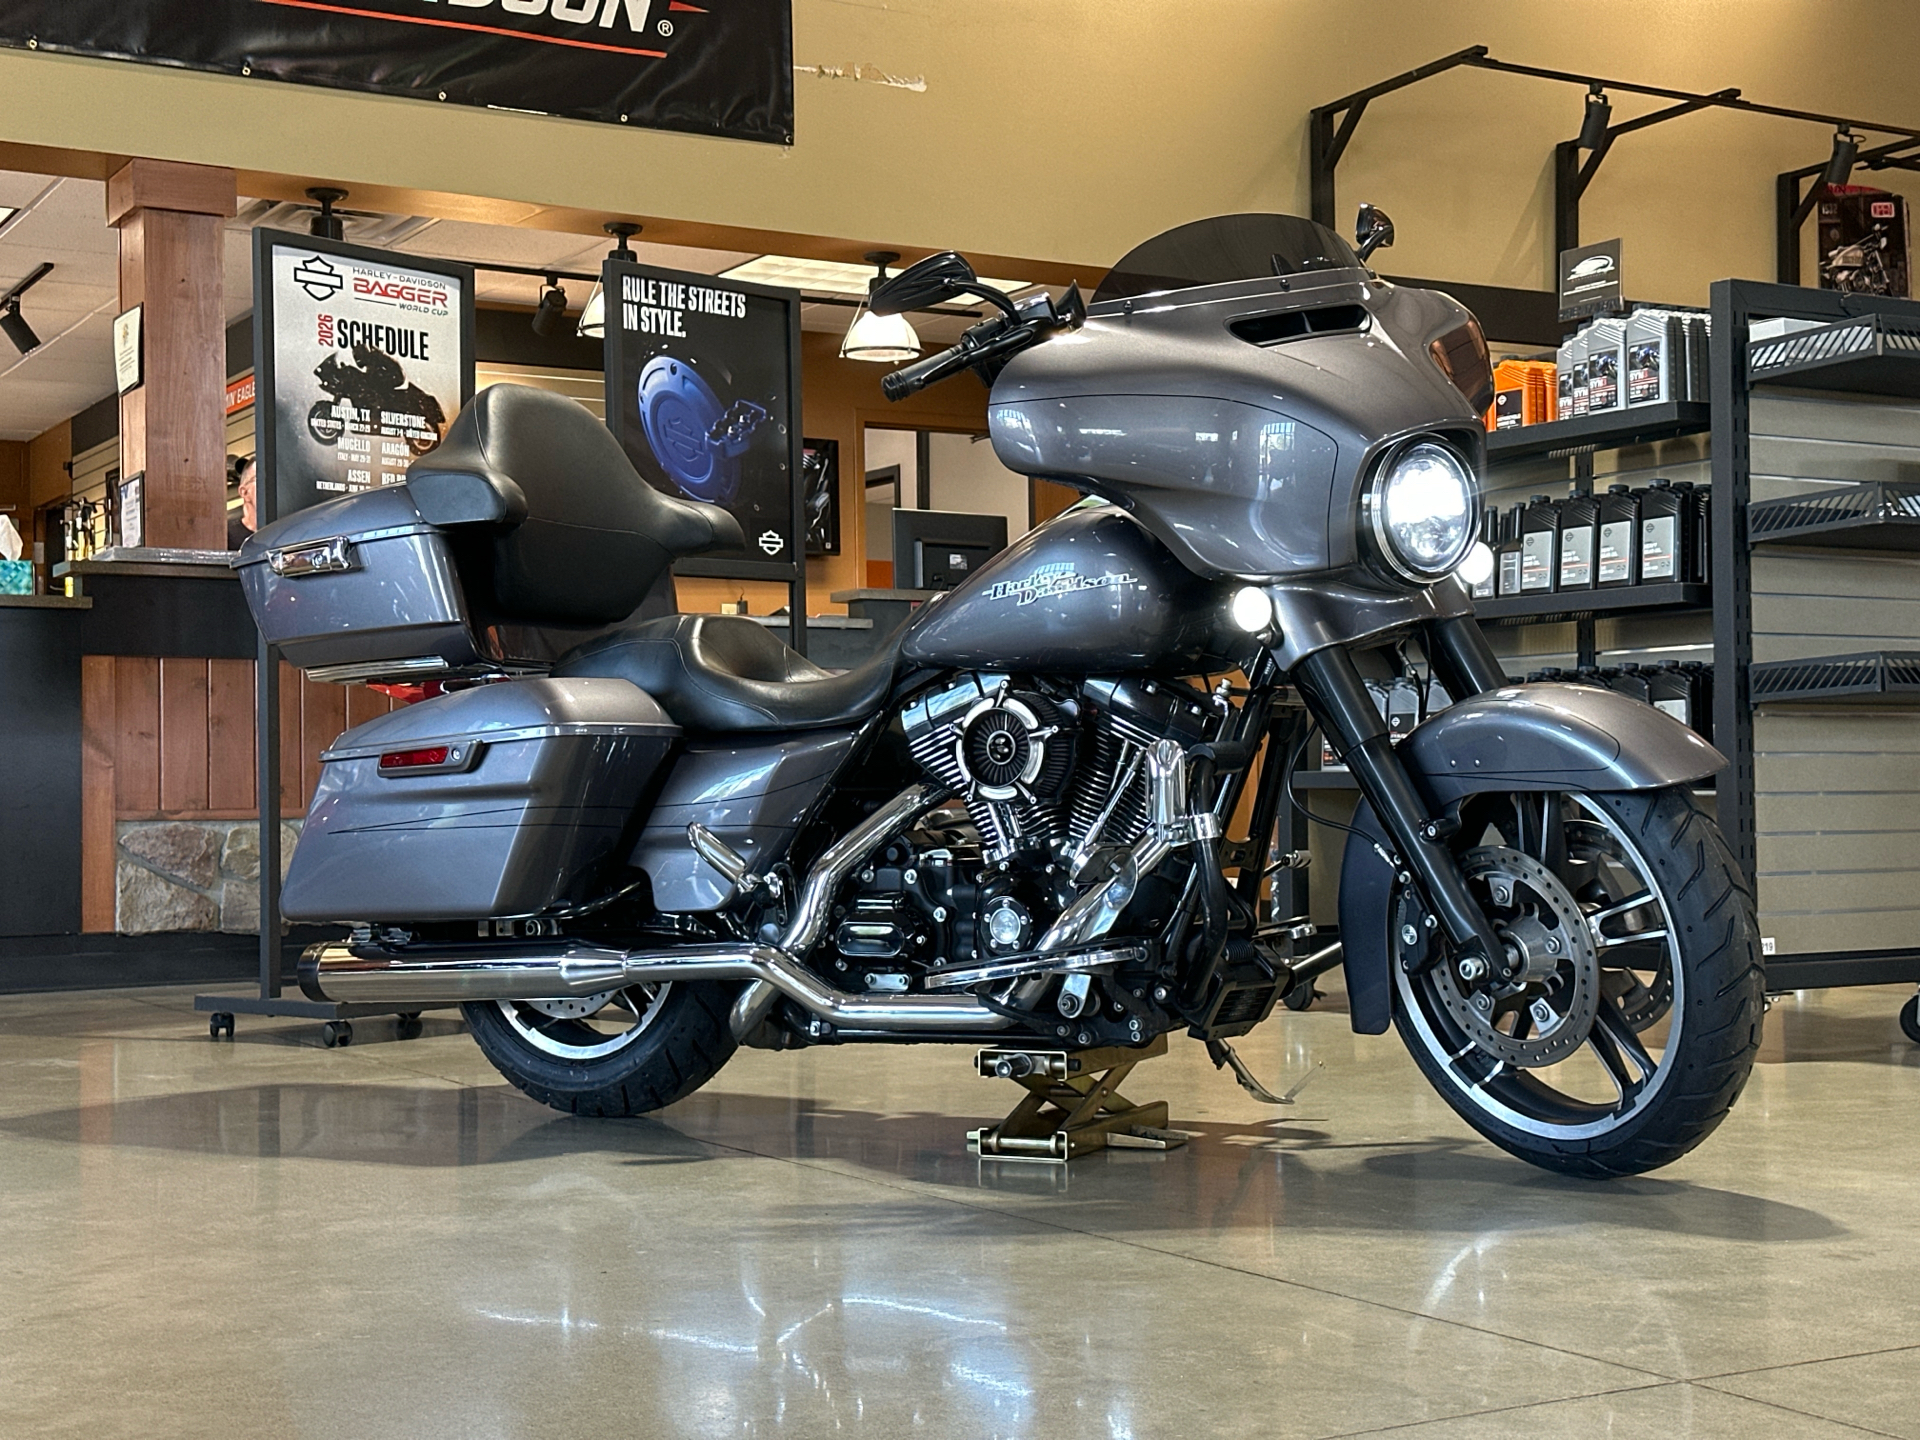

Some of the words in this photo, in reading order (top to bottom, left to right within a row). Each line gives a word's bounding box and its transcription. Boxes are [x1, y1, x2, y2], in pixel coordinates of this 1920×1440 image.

[353, 277, 448, 308] BAGGER
[622, 275, 657, 305] RULE
[659, 281, 686, 310] THE
[688, 286, 746, 319] STREETS
[399, 303, 430, 314] WORLD
[431, 308, 449, 317] CUP
[622, 302, 639, 331] IN
[640, 306, 687, 338] STYLE.
[317, 313, 334, 347] 2026
[337, 318, 430, 361] SCHEDULE
[360, 408, 371, 422] TX
[380, 410, 426, 429] SILVERSTONE
[347, 469, 371, 484] ASSEN
